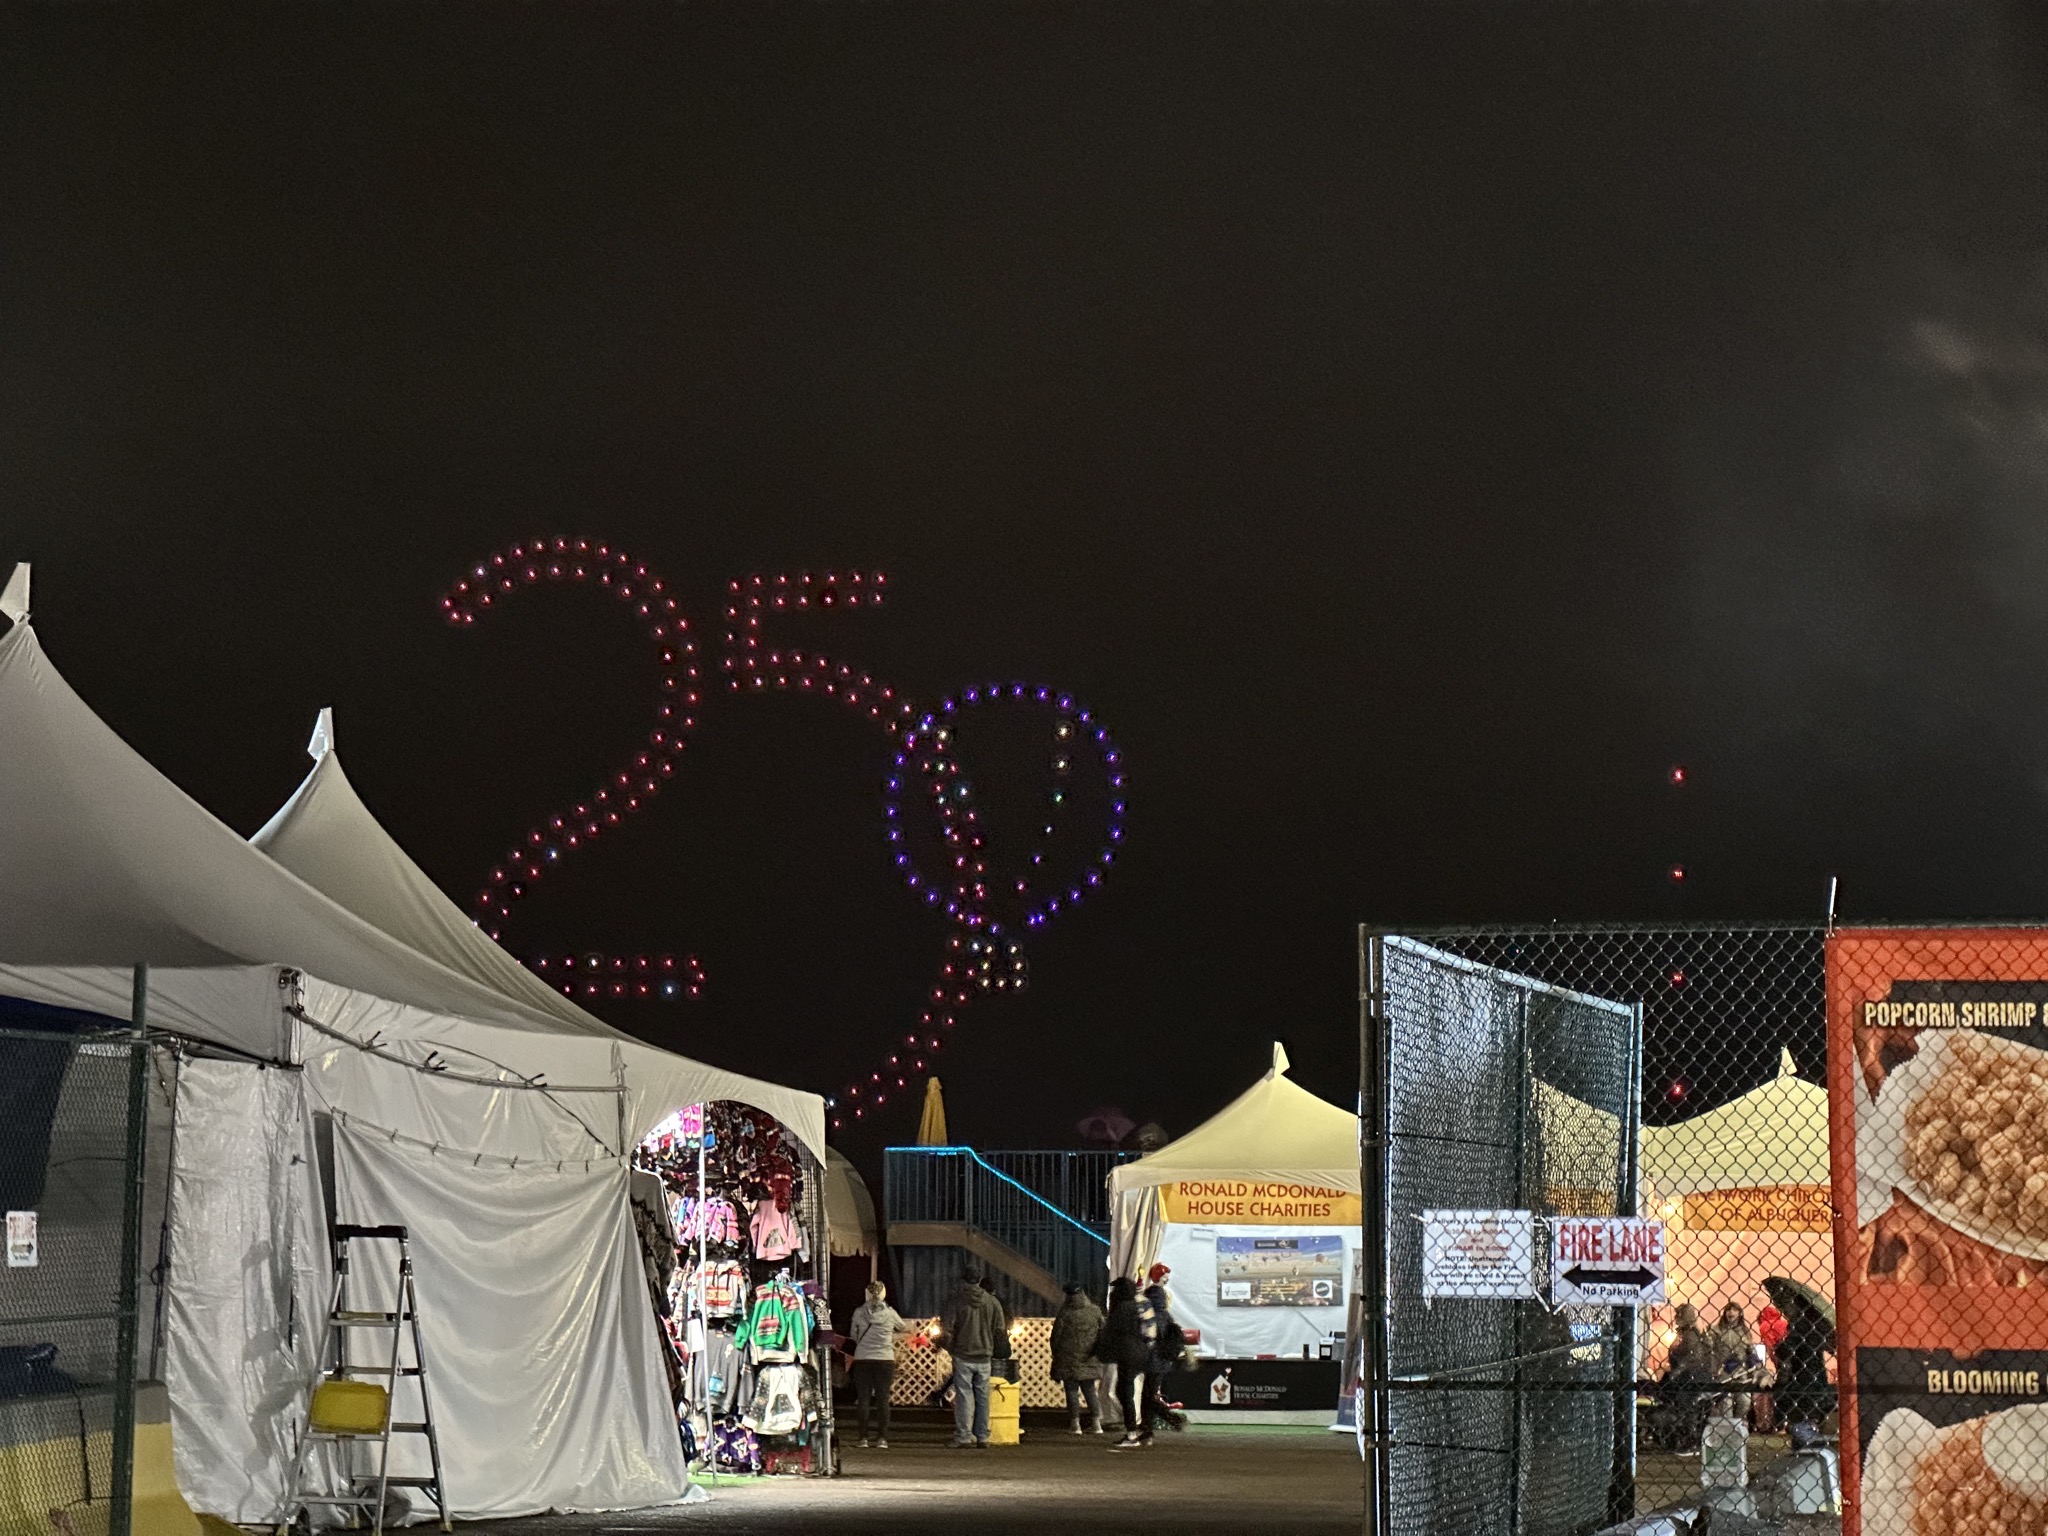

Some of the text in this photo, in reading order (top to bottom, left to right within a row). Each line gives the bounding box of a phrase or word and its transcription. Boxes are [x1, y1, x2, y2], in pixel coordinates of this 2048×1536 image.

[1865, 1002, 1955, 1027] POPCORN
[1961, 1002, 2037, 1027] SHRIMP
[1180, 1182, 1247, 1196] RONALD
[1188, 1201, 1331, 1217] HOUSE CHARITIES
[1721, 1208, 1832, 1223] OF ALBUQUER
[1560, 1224, 1660, 1263] FIRE LANE
[1582, 1286, 1639, 1299] No Parking
[1928, 1370, 2040, 1395] BLOOMING
